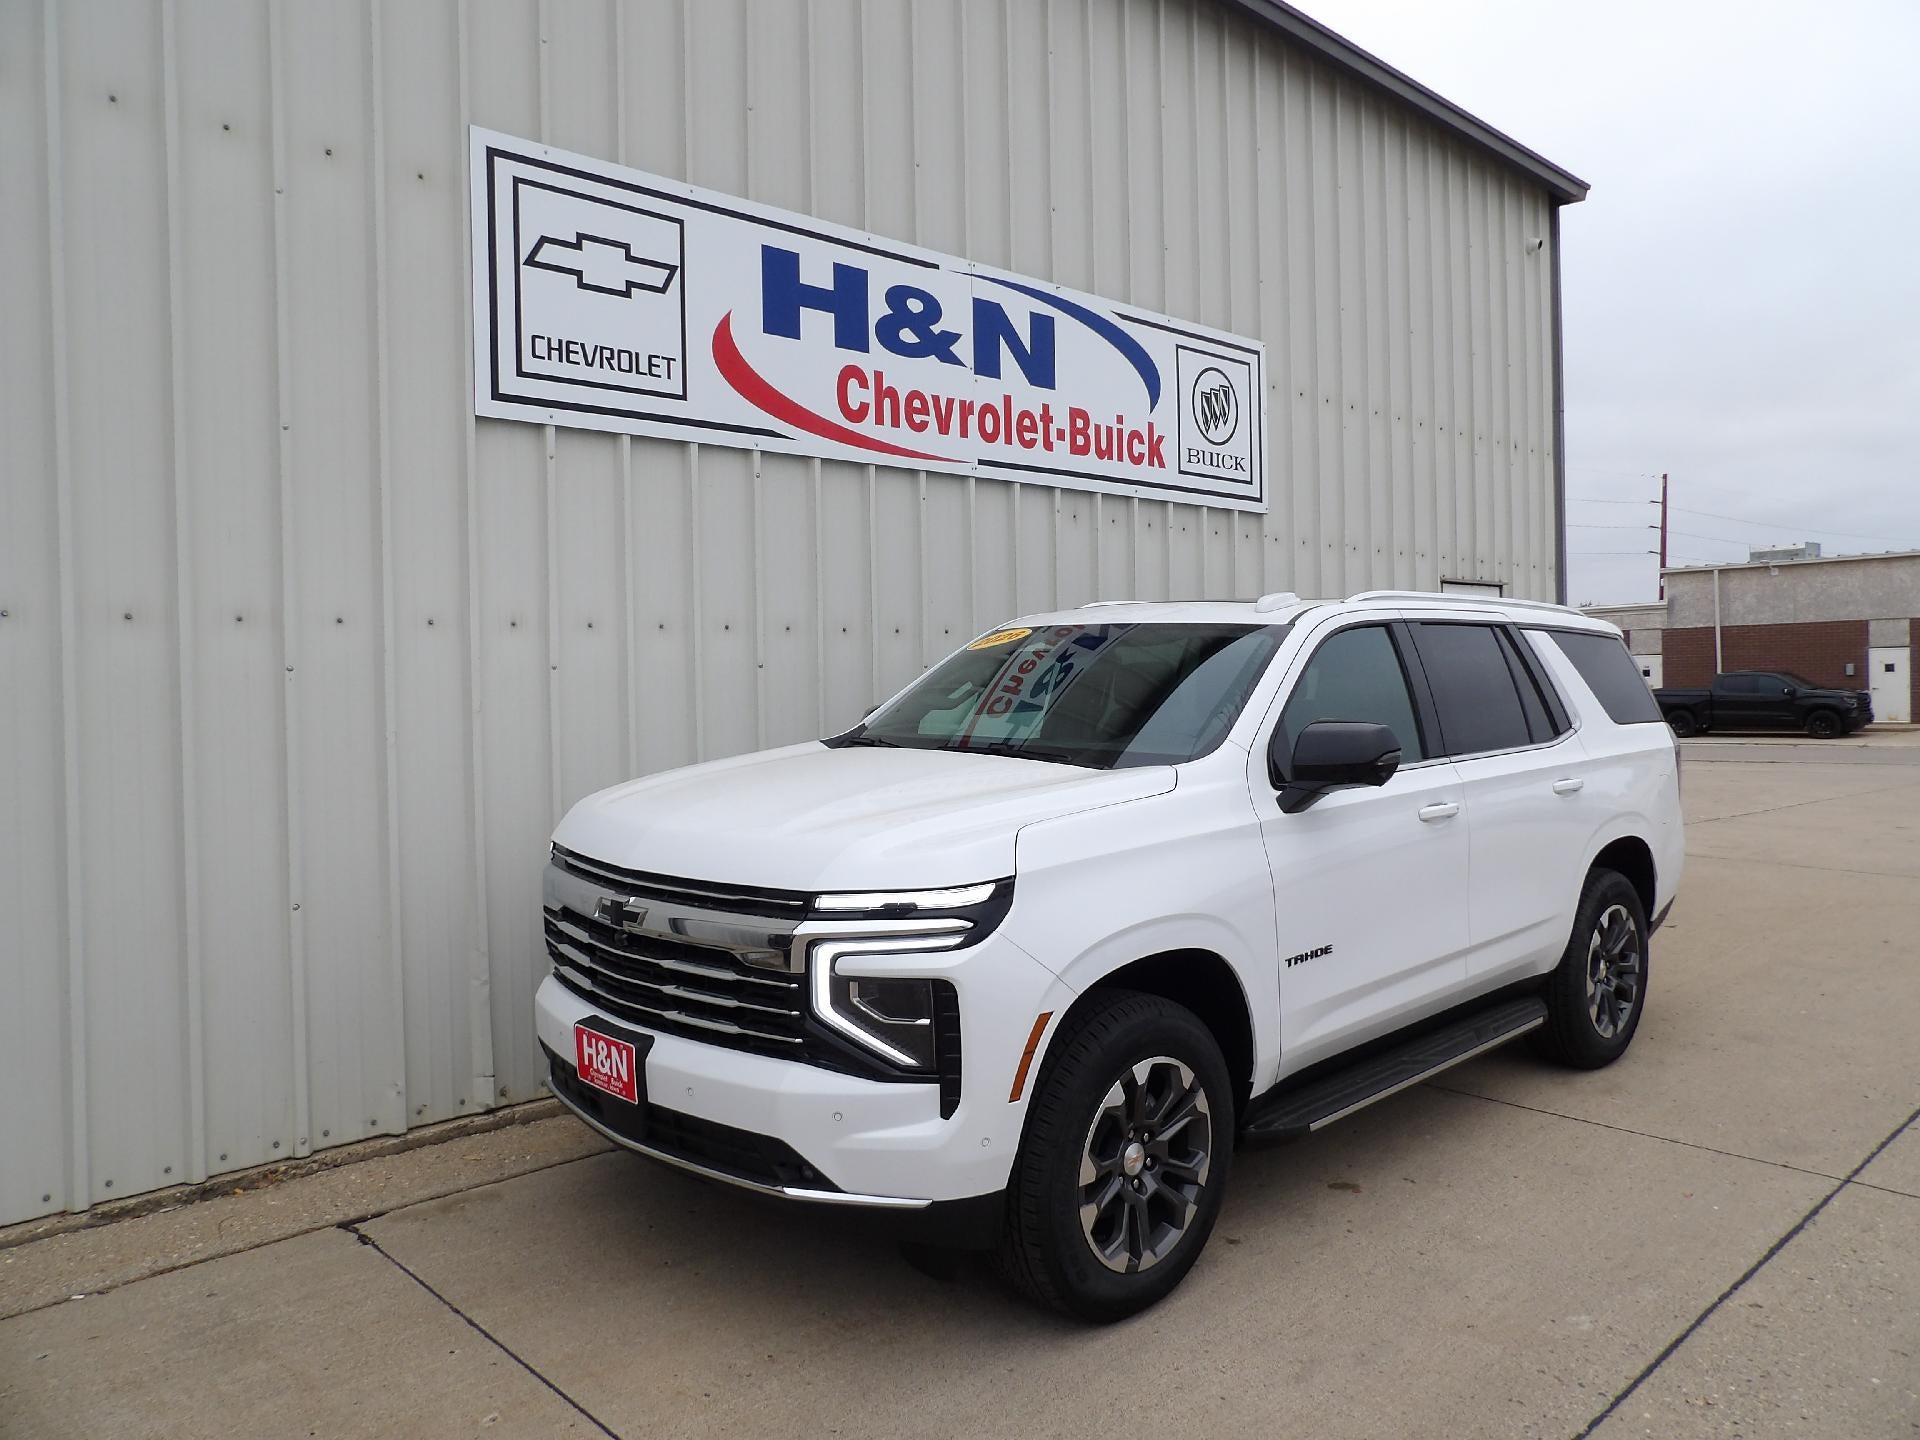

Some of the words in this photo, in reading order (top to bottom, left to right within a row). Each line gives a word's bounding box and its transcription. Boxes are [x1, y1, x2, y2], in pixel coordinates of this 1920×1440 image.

[761, 244, 1056, 390] H&N
[531, 334, 677, 380] CHEVROLET
[836, 364, 1166, 468] Chevrolet-Buick
[1186, 447, 1246, 472] BUICK
[1284, 944, 1333, 968] TAHOE
[583, 1033, 628, 1082] H&N
